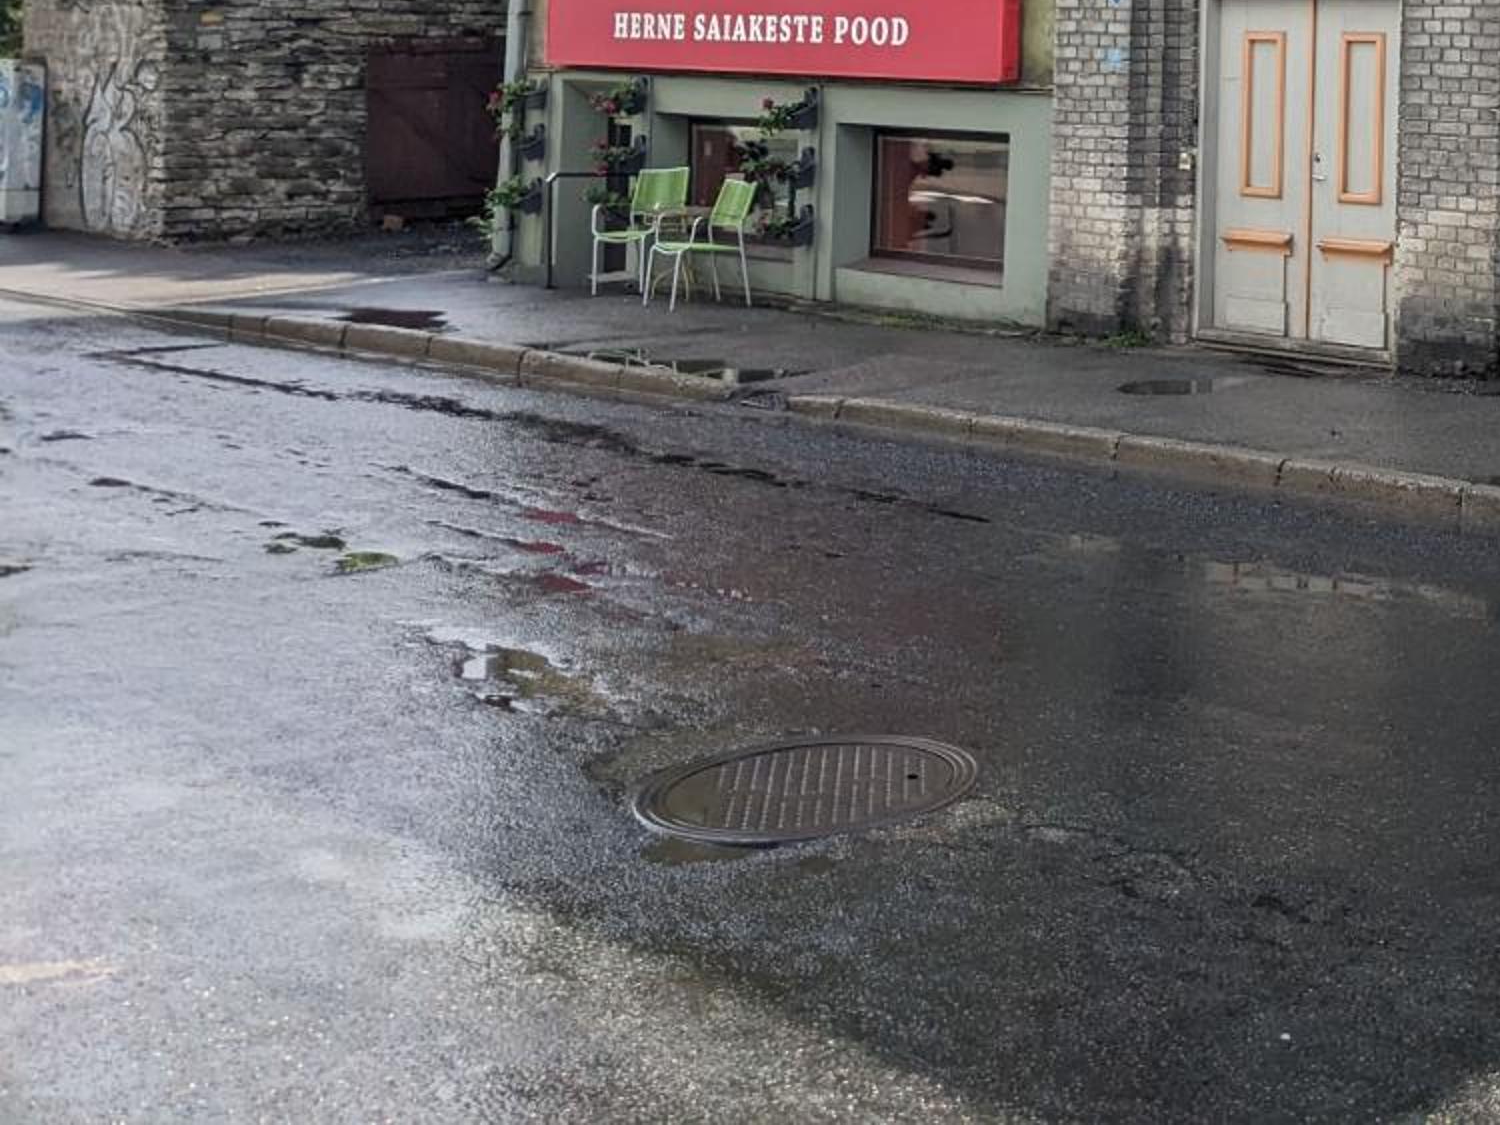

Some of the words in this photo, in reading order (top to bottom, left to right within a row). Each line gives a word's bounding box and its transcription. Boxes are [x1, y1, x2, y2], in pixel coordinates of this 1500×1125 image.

[613, 12, 686, 40] HERNE
[693, 13, 824, 44] SAIAKESTE
[833, 16, 909, 46] POOD
